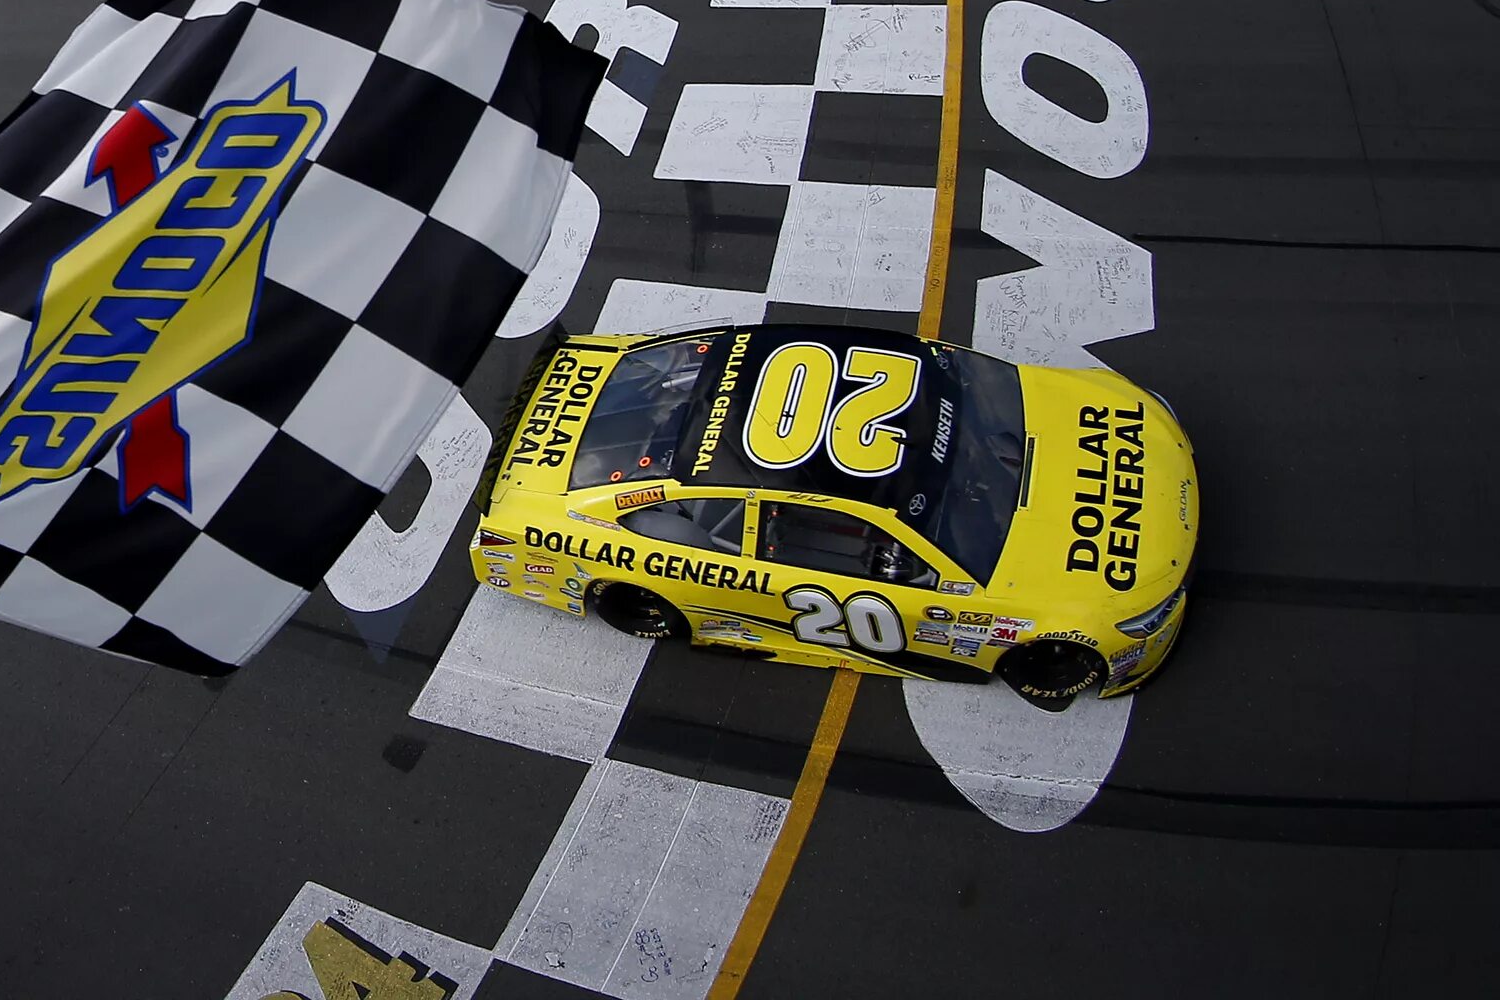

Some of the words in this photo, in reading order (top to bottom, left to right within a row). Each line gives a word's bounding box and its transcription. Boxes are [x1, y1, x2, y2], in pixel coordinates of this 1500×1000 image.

[716, 333, 751, 397] DOLLAR
[512, 351, 578, 470] GENERAL
[537, 364, 604, 469] DOLLAR
[691, 394, 731, 477] GENERAL
[743, 341, 922, 477] 20
[930, 398, 954, 464] KENSETH
[1066, 404, 1110, 574] DOLLAR
[1104, 402, 1145, 592] GENERAL
[1178, 480, 1188, 523] GILDAN
[489, 577, 510, 587] STP
[524, 526, 636, 572] DOLLAR
[643, 551, 776, 597] GENERAL
[526, 565, 553, 574] GLAD
[635, 629, 672, 640] EAGLE
[782, 584, 907, 655] 20
[953, 624, 978, 634] Mobil
[991, 627, 1019, 642] 3M
